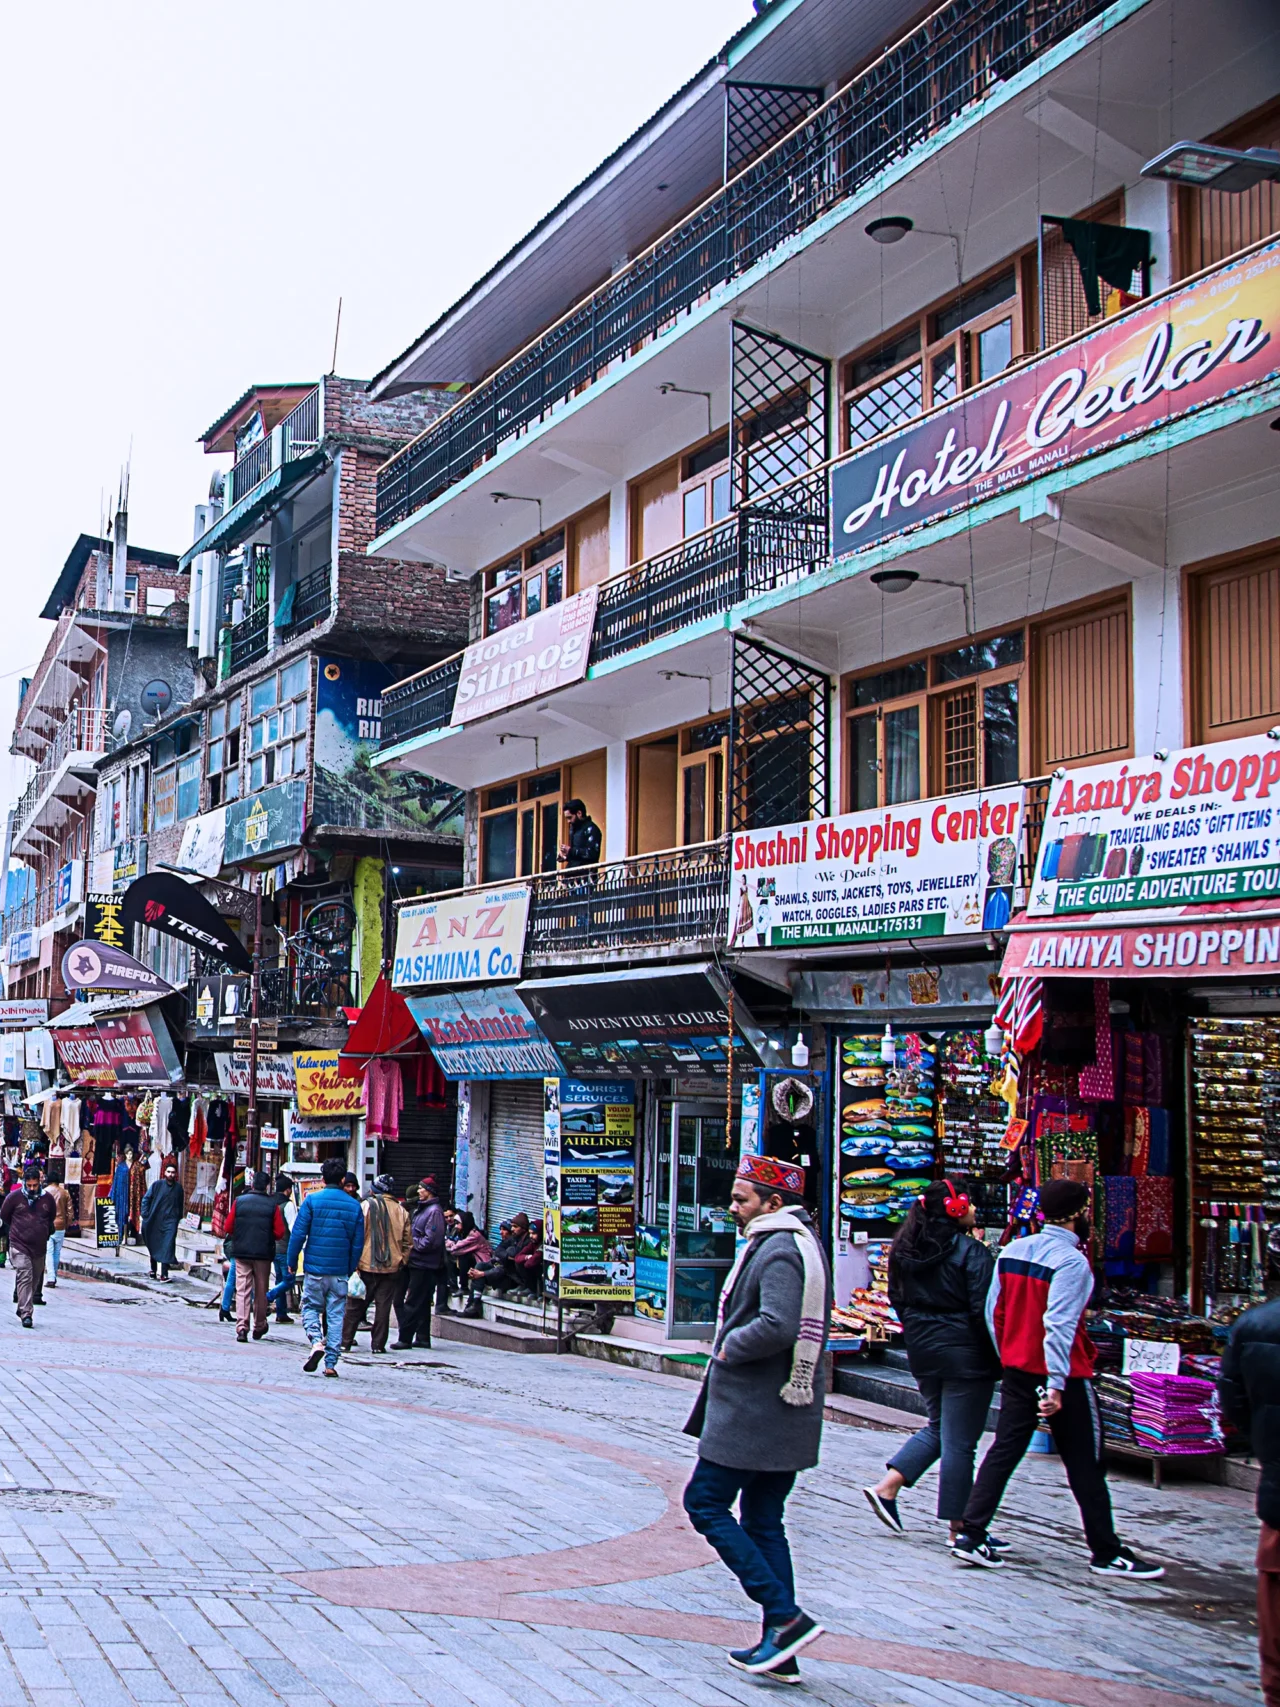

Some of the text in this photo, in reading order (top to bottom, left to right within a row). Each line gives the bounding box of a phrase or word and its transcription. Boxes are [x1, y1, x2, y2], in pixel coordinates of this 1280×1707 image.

[843, 318, 1271, 534] Hotel Cedar
[975, 445, 1069, 493] THE MALL MANALI
[464, 622, 535, 669] Hotel
[457, 631, 586, 705] Silmog
[1052, 765, 1162, 816] Aaniya
[1109, 822, 1170, 846] TRAVELLING
[1172, 818, 1201, 839] BAGS
[1236, 808, 1272, 831] ITEMS
[1133, 811, 1152, 822] WE
[1155, 804, 1196, 819] DEALS
[734, 799, 1019, 871] Shashni Shopping Center
[815, 864, 897, 883] We Deals In
[775, 872, 978, 907] SHAWLS, SUITS, JACKETS, TOYS, JEWELLERY
[1059, 886, 1087, 908] THE
[1088, 880, 1136, 906] GUIDE
[1138, 871, 1238, 901] ADVENTURE
[782, 896, 950, 924] WATCH, GOGGLES, LADIES PARS ETC.
[167, 914, 229, 952] TREK
[781, 916, 923, 939] THE MALL MANALI-175131
[1023, 926, 1280, 968] AANIYA SHOPPIN
[104, 963, 158, 985] FIREFOX
[394, 946, 518, 983] PASHMINA Co.
[424, 1007, 531, 1044] Kashmir
[568, 1010, 730, 1030] ADVENTURE TOURS
[296, 1055, 319, 1069] Value
[436, 1049, 471, 1075] CRAFT
[240, 1071, 275, 1090] Diount
[568, 1085, 625, 1093] TOURIST
[564, 1137, 632, 1146] AIRLINES
[658, 1152, 738, 1171] ADVTURE TOURS
[563, 1286, 632, 1296] Train Reservations
